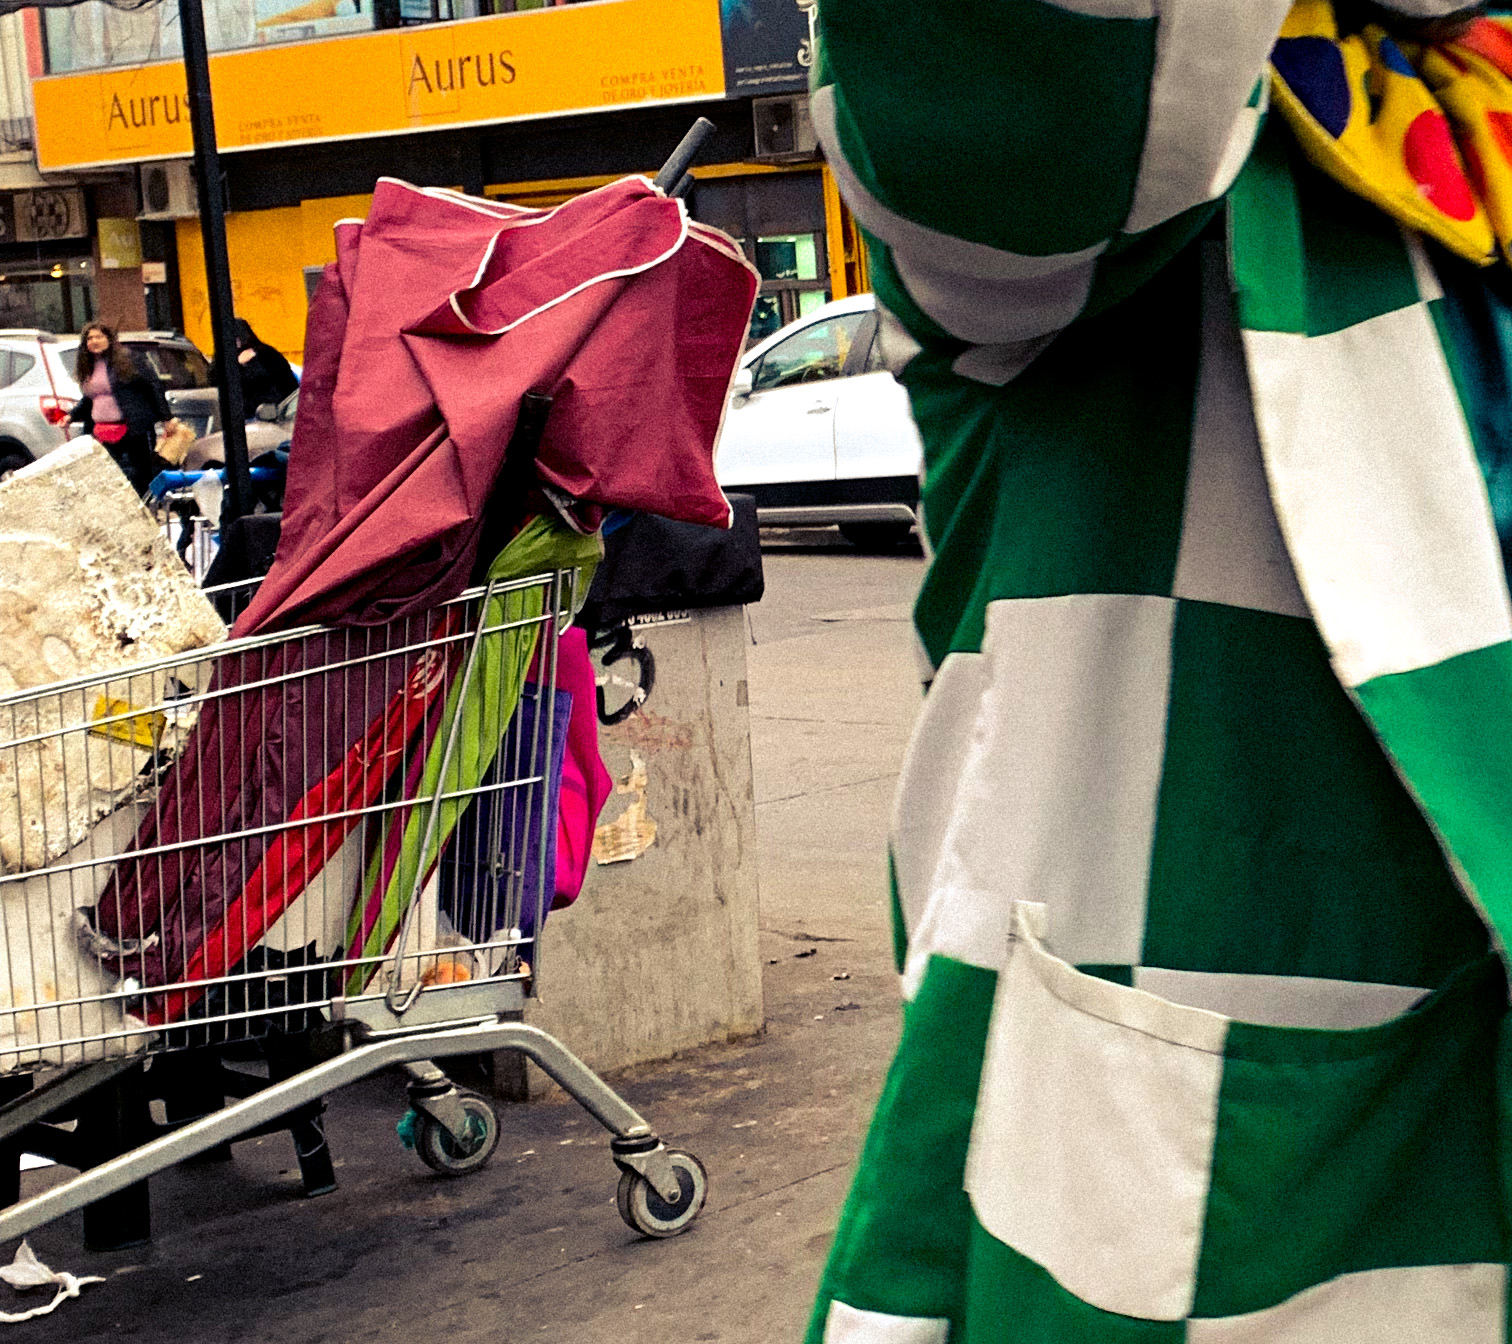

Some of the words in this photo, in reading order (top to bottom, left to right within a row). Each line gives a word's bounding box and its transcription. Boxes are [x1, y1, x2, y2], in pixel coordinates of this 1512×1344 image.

[408, 50, 517, 95] Aurus
[601, 72, 655, 88] COMPRA
[662, 65, 705, 80] VENTA
